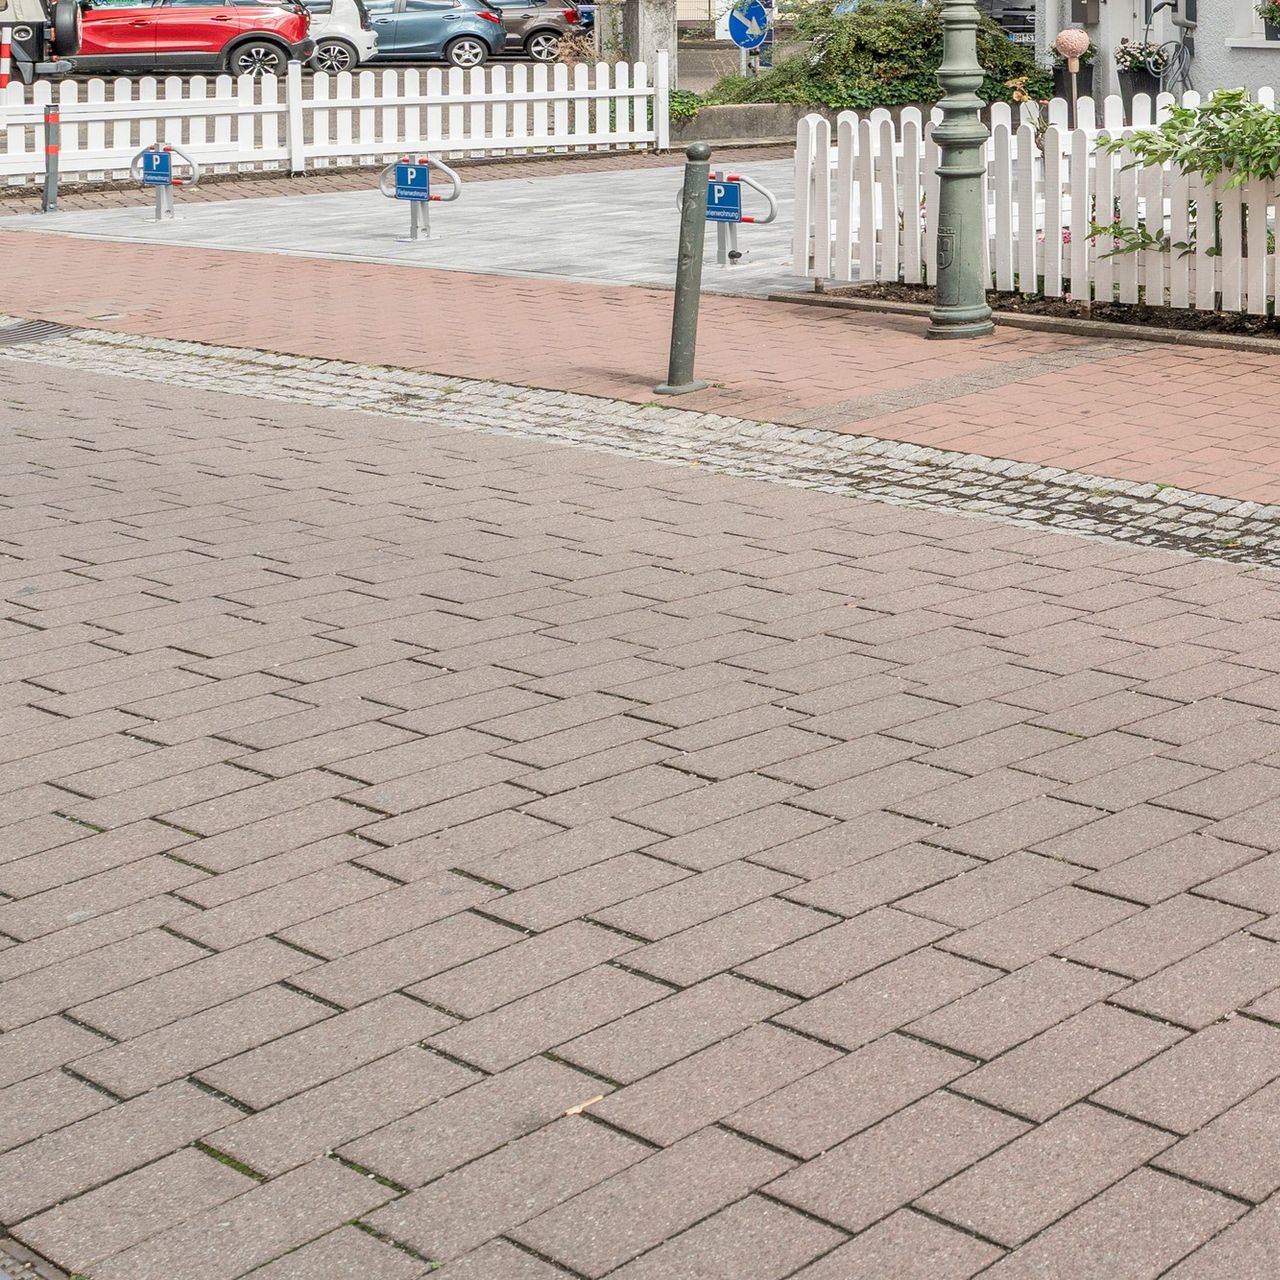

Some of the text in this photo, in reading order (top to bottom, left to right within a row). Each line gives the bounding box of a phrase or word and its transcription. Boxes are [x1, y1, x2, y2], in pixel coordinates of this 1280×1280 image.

[153, 155, 160, 170] P
[407, 168, 416, 184] P
[714, 185, 725, 204] P
